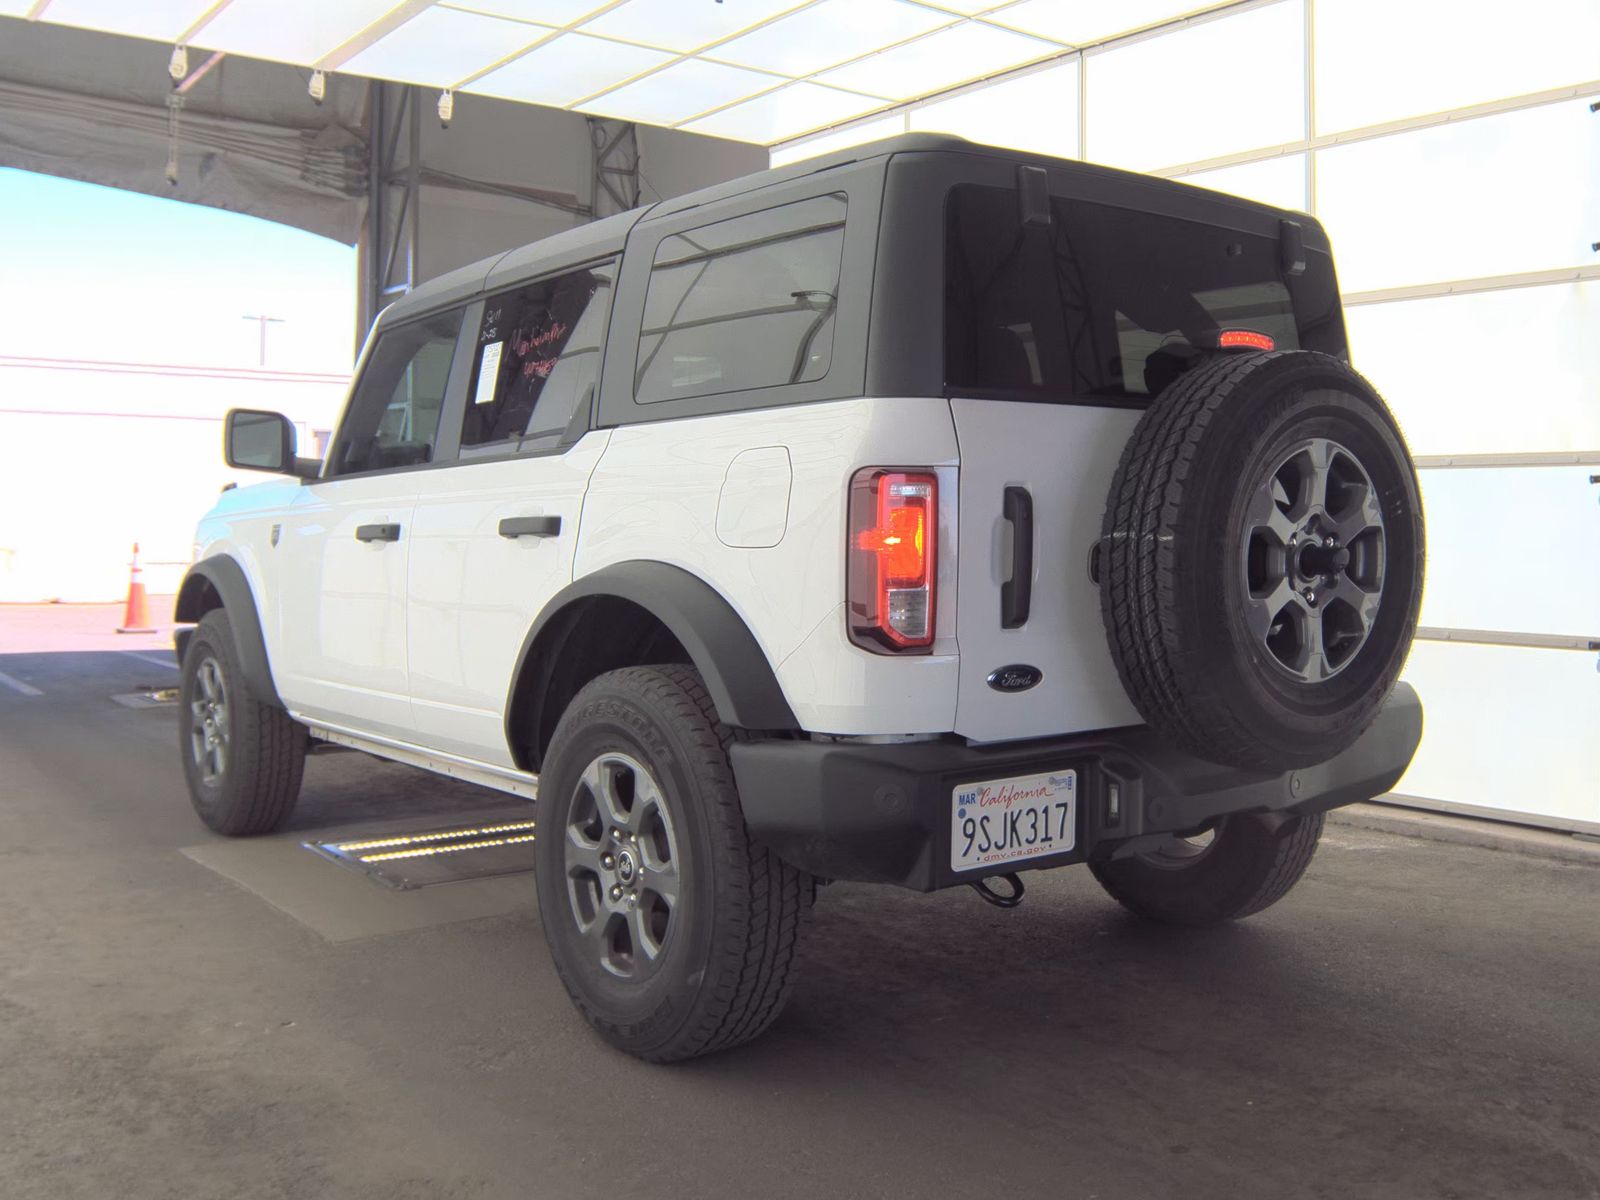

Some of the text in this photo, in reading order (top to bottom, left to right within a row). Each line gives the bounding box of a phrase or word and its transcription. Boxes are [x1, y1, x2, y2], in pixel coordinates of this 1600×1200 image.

[1001, 671, 1032, 686] Ford
[958, 793, 976, 805] MAR
[979, 782, 1055, 809] California
[962, 802, 1068, 857] 9SJK317
[983, 845, 1047, 862] dmv.ca.gov
